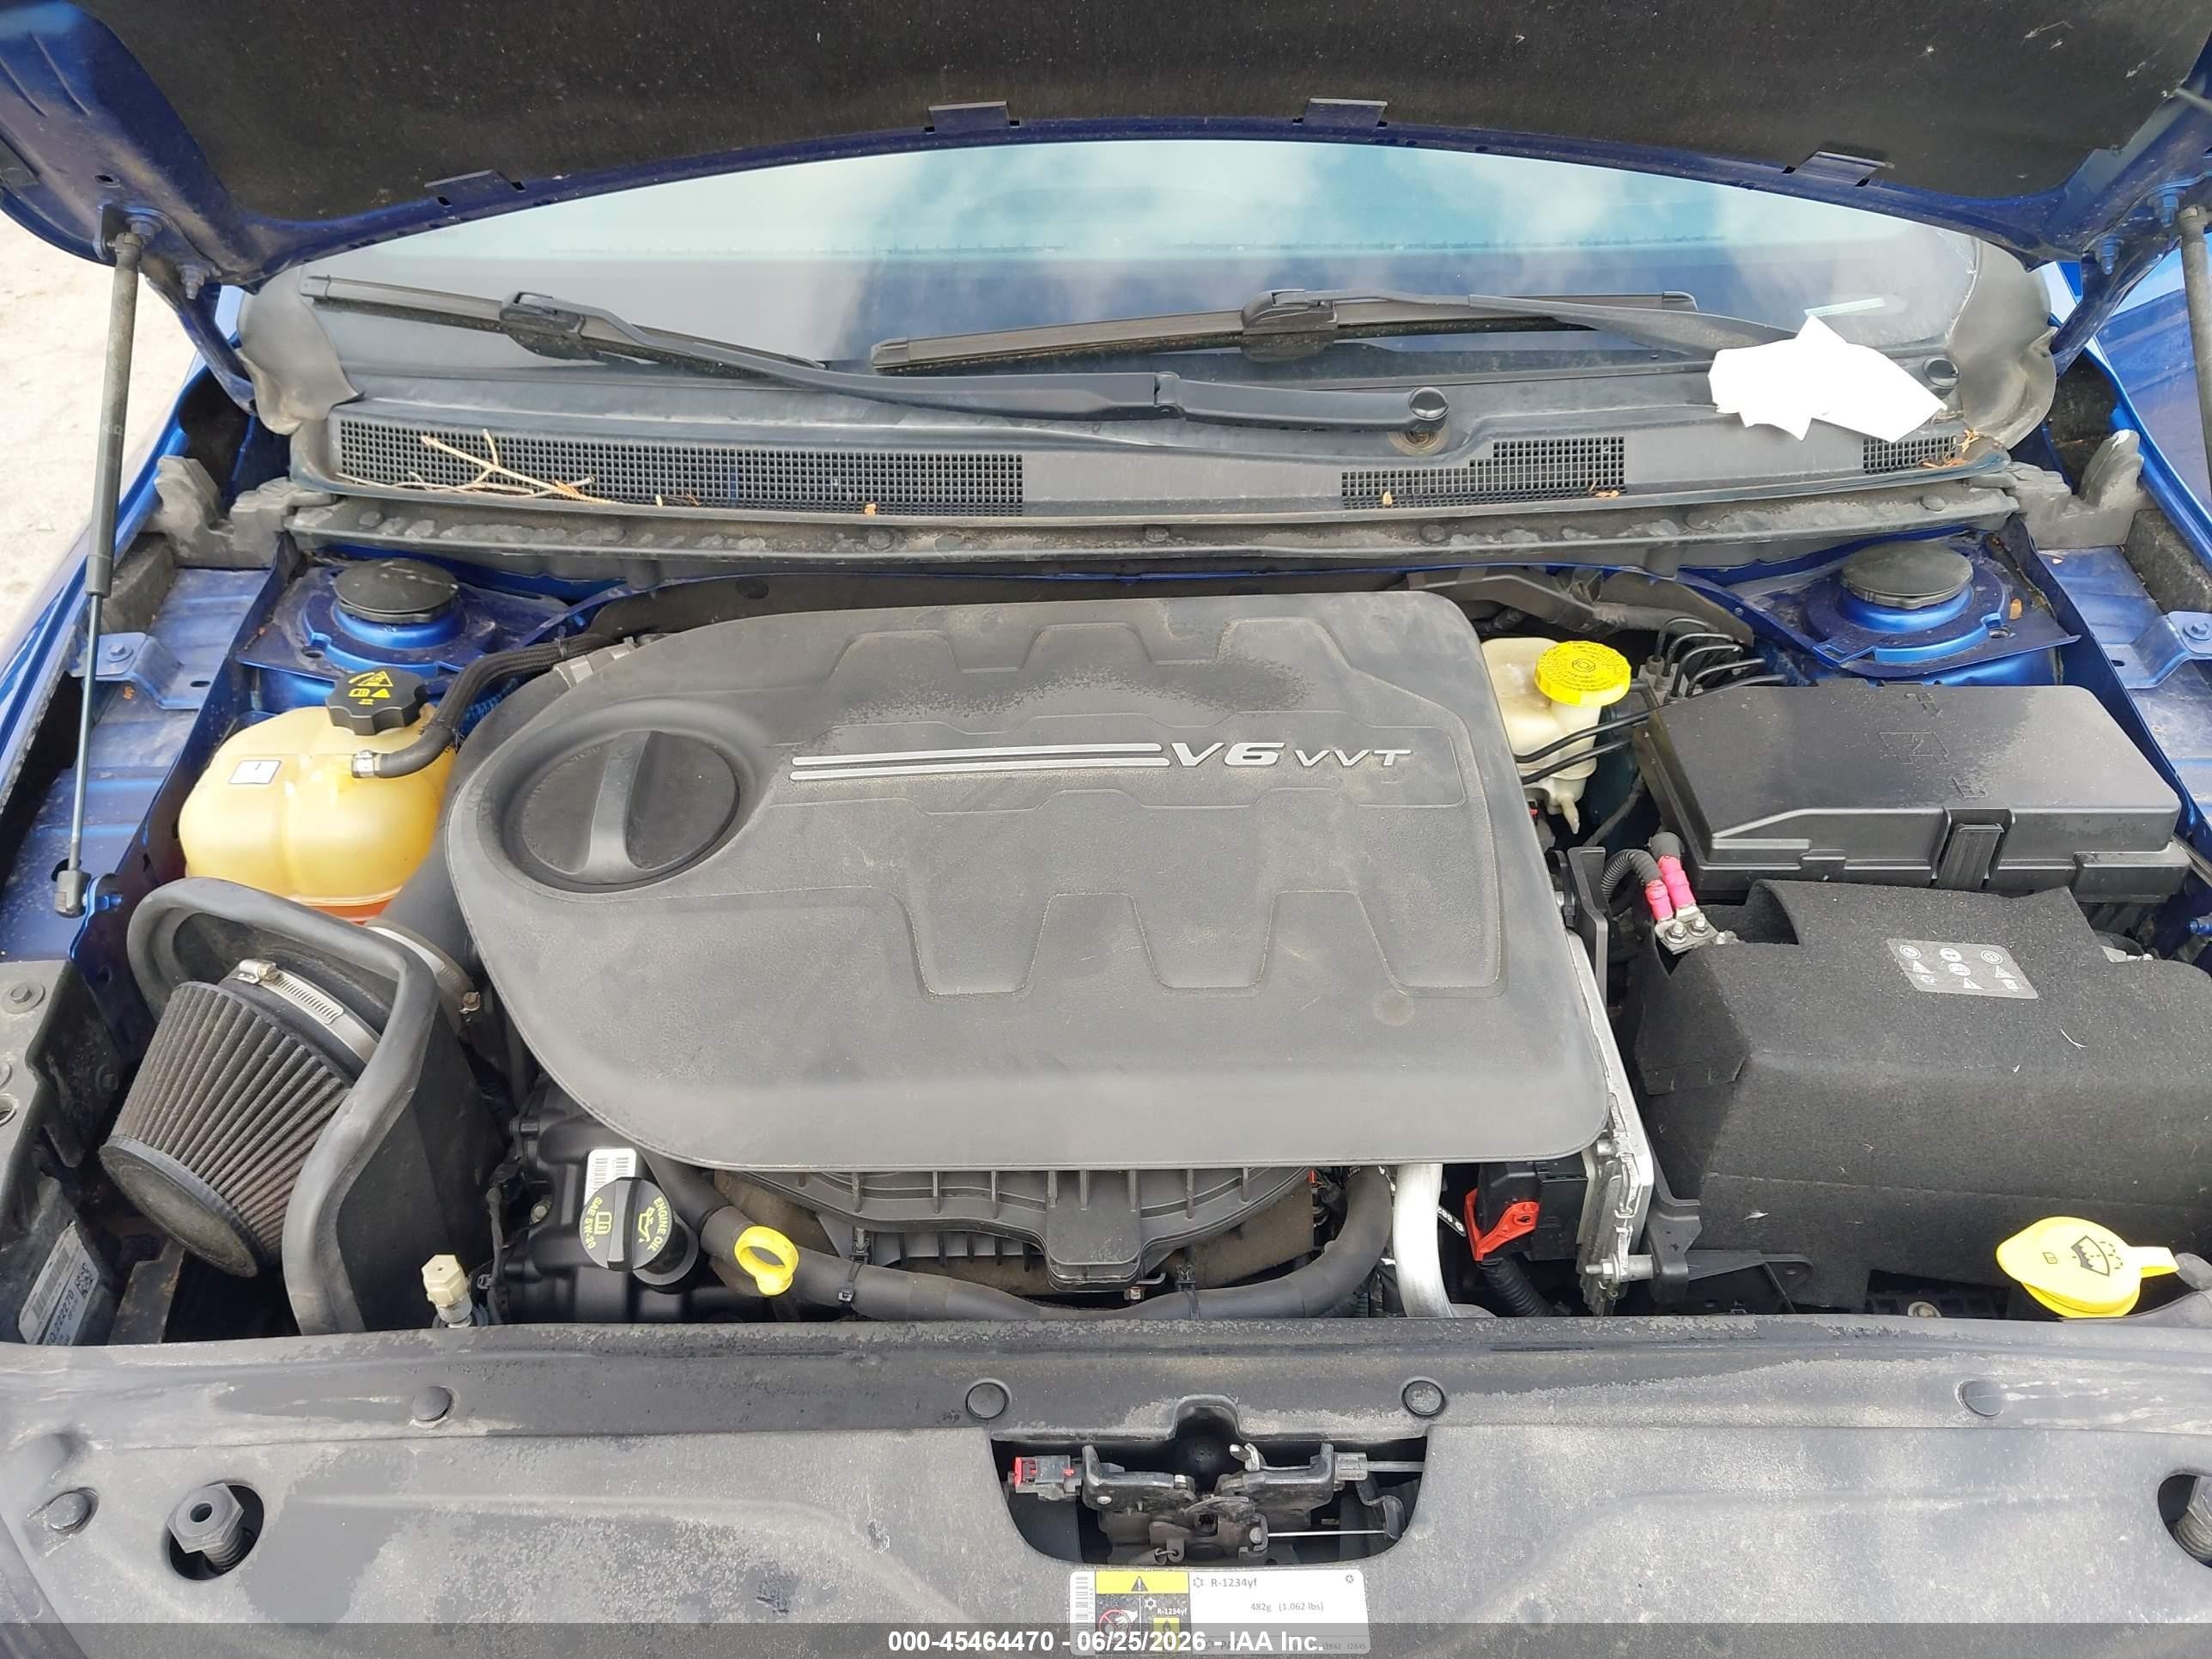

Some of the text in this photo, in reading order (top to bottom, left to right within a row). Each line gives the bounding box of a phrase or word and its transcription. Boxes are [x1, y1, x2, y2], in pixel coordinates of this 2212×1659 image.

[1170, 742, 1412, 768] V6 VVT
[586, 1196, 603, 1217] SAE
[647, 1196, 668, 1252] ENGINE OIL
[1211, 1577, 1258, 1589] R-1234yf
[1250, 1601, 1324, 1613] 482g (1.062 lbs)
